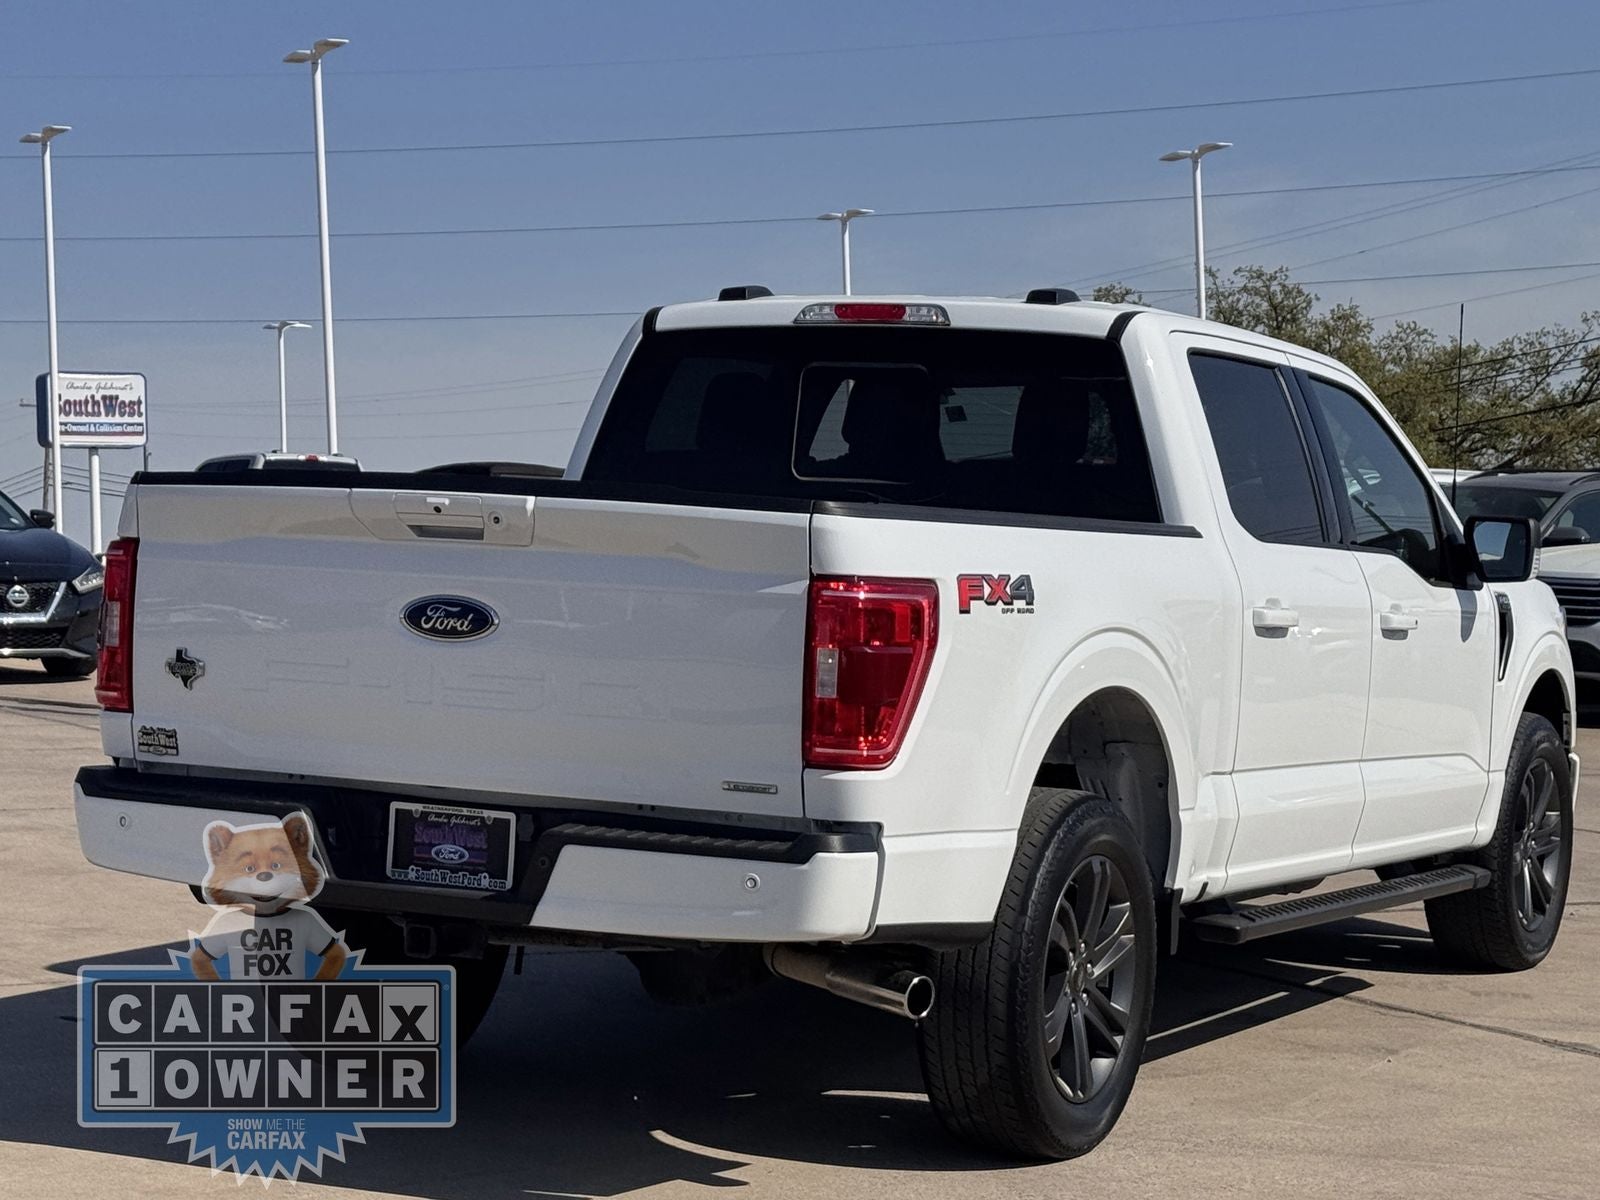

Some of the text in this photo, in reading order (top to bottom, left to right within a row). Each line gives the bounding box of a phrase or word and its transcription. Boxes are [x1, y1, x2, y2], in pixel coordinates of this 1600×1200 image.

[956, 573, 1035, 614] FX4
[421, 604, 474, 631] Ford
[439, 848, 461, 860] Ford
